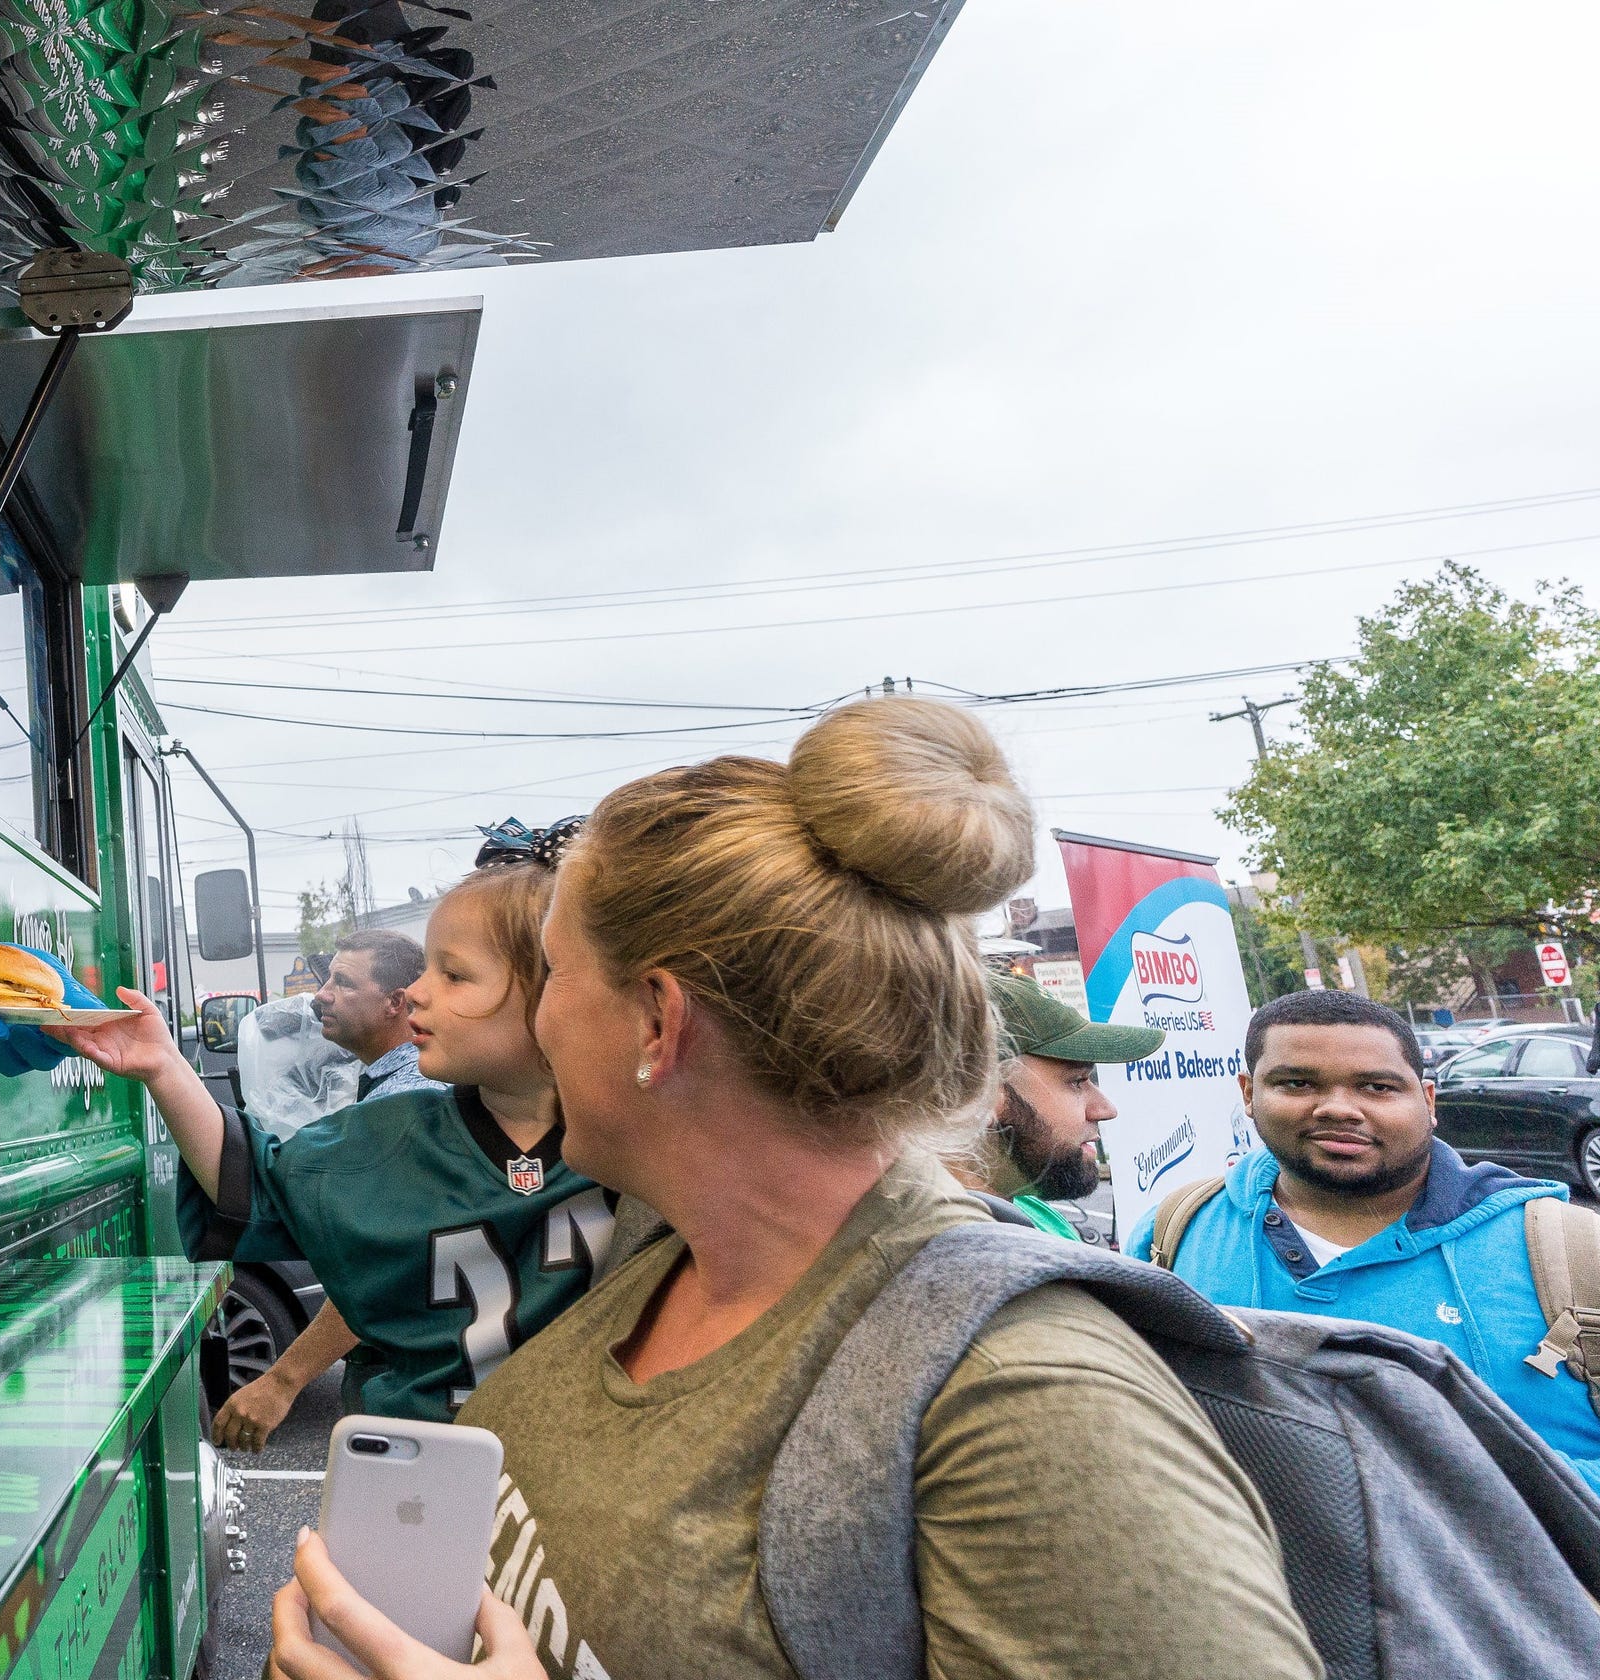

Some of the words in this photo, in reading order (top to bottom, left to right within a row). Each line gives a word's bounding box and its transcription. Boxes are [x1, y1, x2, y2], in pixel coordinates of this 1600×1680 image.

[1042, 979, 1063, 987] ACME
[1134, 950, 1198, 986] BIMBO
[1125, 1050, 1172, 1082] Proud
[1174, 1049, 1226, 1080] Bakers
[1227, 1048, 1242, 1077] of
[82, 1056, 105, 1112] you
[1133, 1114, 1197, 1192] Entenmann's
[514, 1172, 539, 1189] NFL
